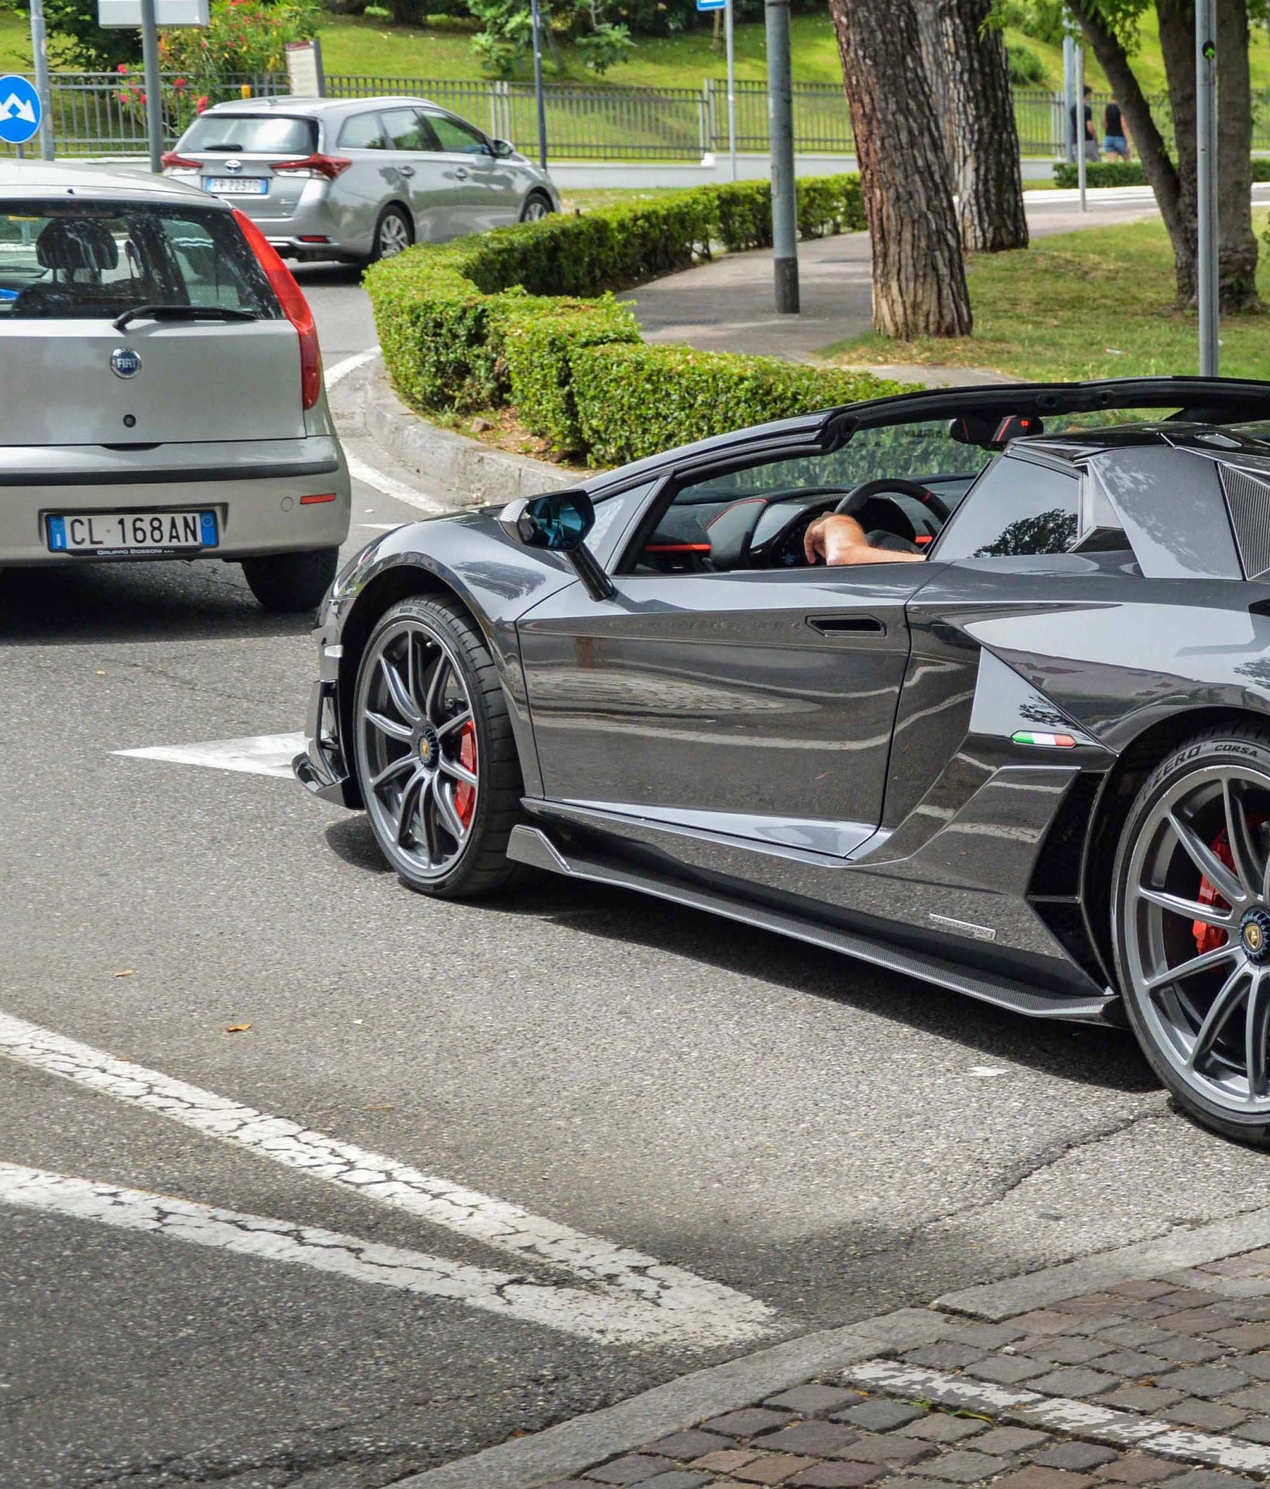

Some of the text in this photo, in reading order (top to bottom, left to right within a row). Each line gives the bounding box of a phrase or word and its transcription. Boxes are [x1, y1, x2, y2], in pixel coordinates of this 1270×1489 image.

[116, 358, 137, 369] FIAT
[70, 518, 104, 545] CL
[117, 515, 198, 544] 168AN
[1214, 743, 1259, 759] CORSA
